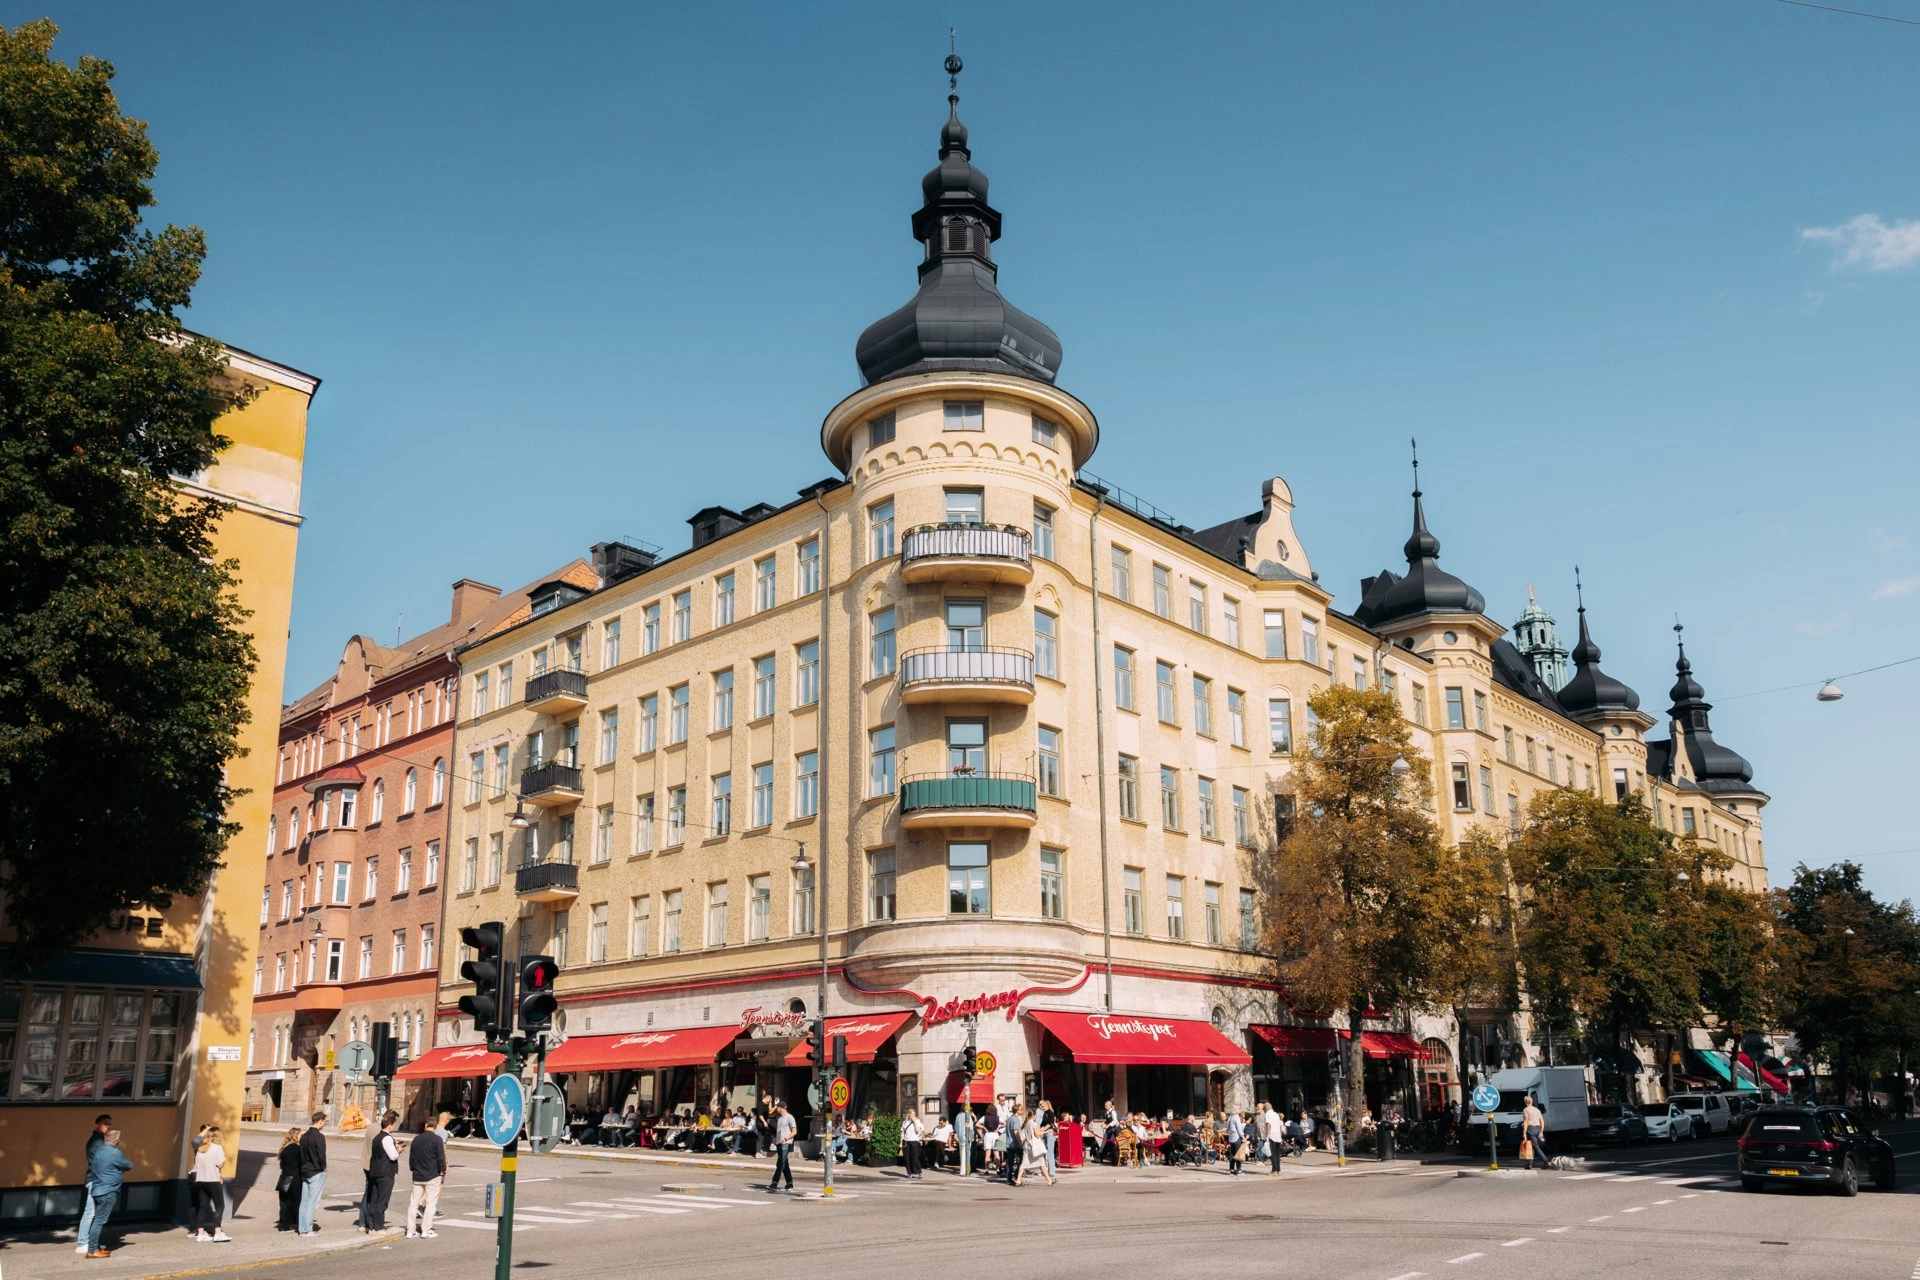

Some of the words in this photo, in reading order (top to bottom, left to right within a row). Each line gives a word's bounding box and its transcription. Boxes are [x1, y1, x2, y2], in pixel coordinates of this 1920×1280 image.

[922, 989, 1018, 1032] Restaurang
[1087, 1015, 1176, 1041] Tennstopet
[978, 1057, 993, 1071] 30
[833, 1086, 847, 1101] 30
